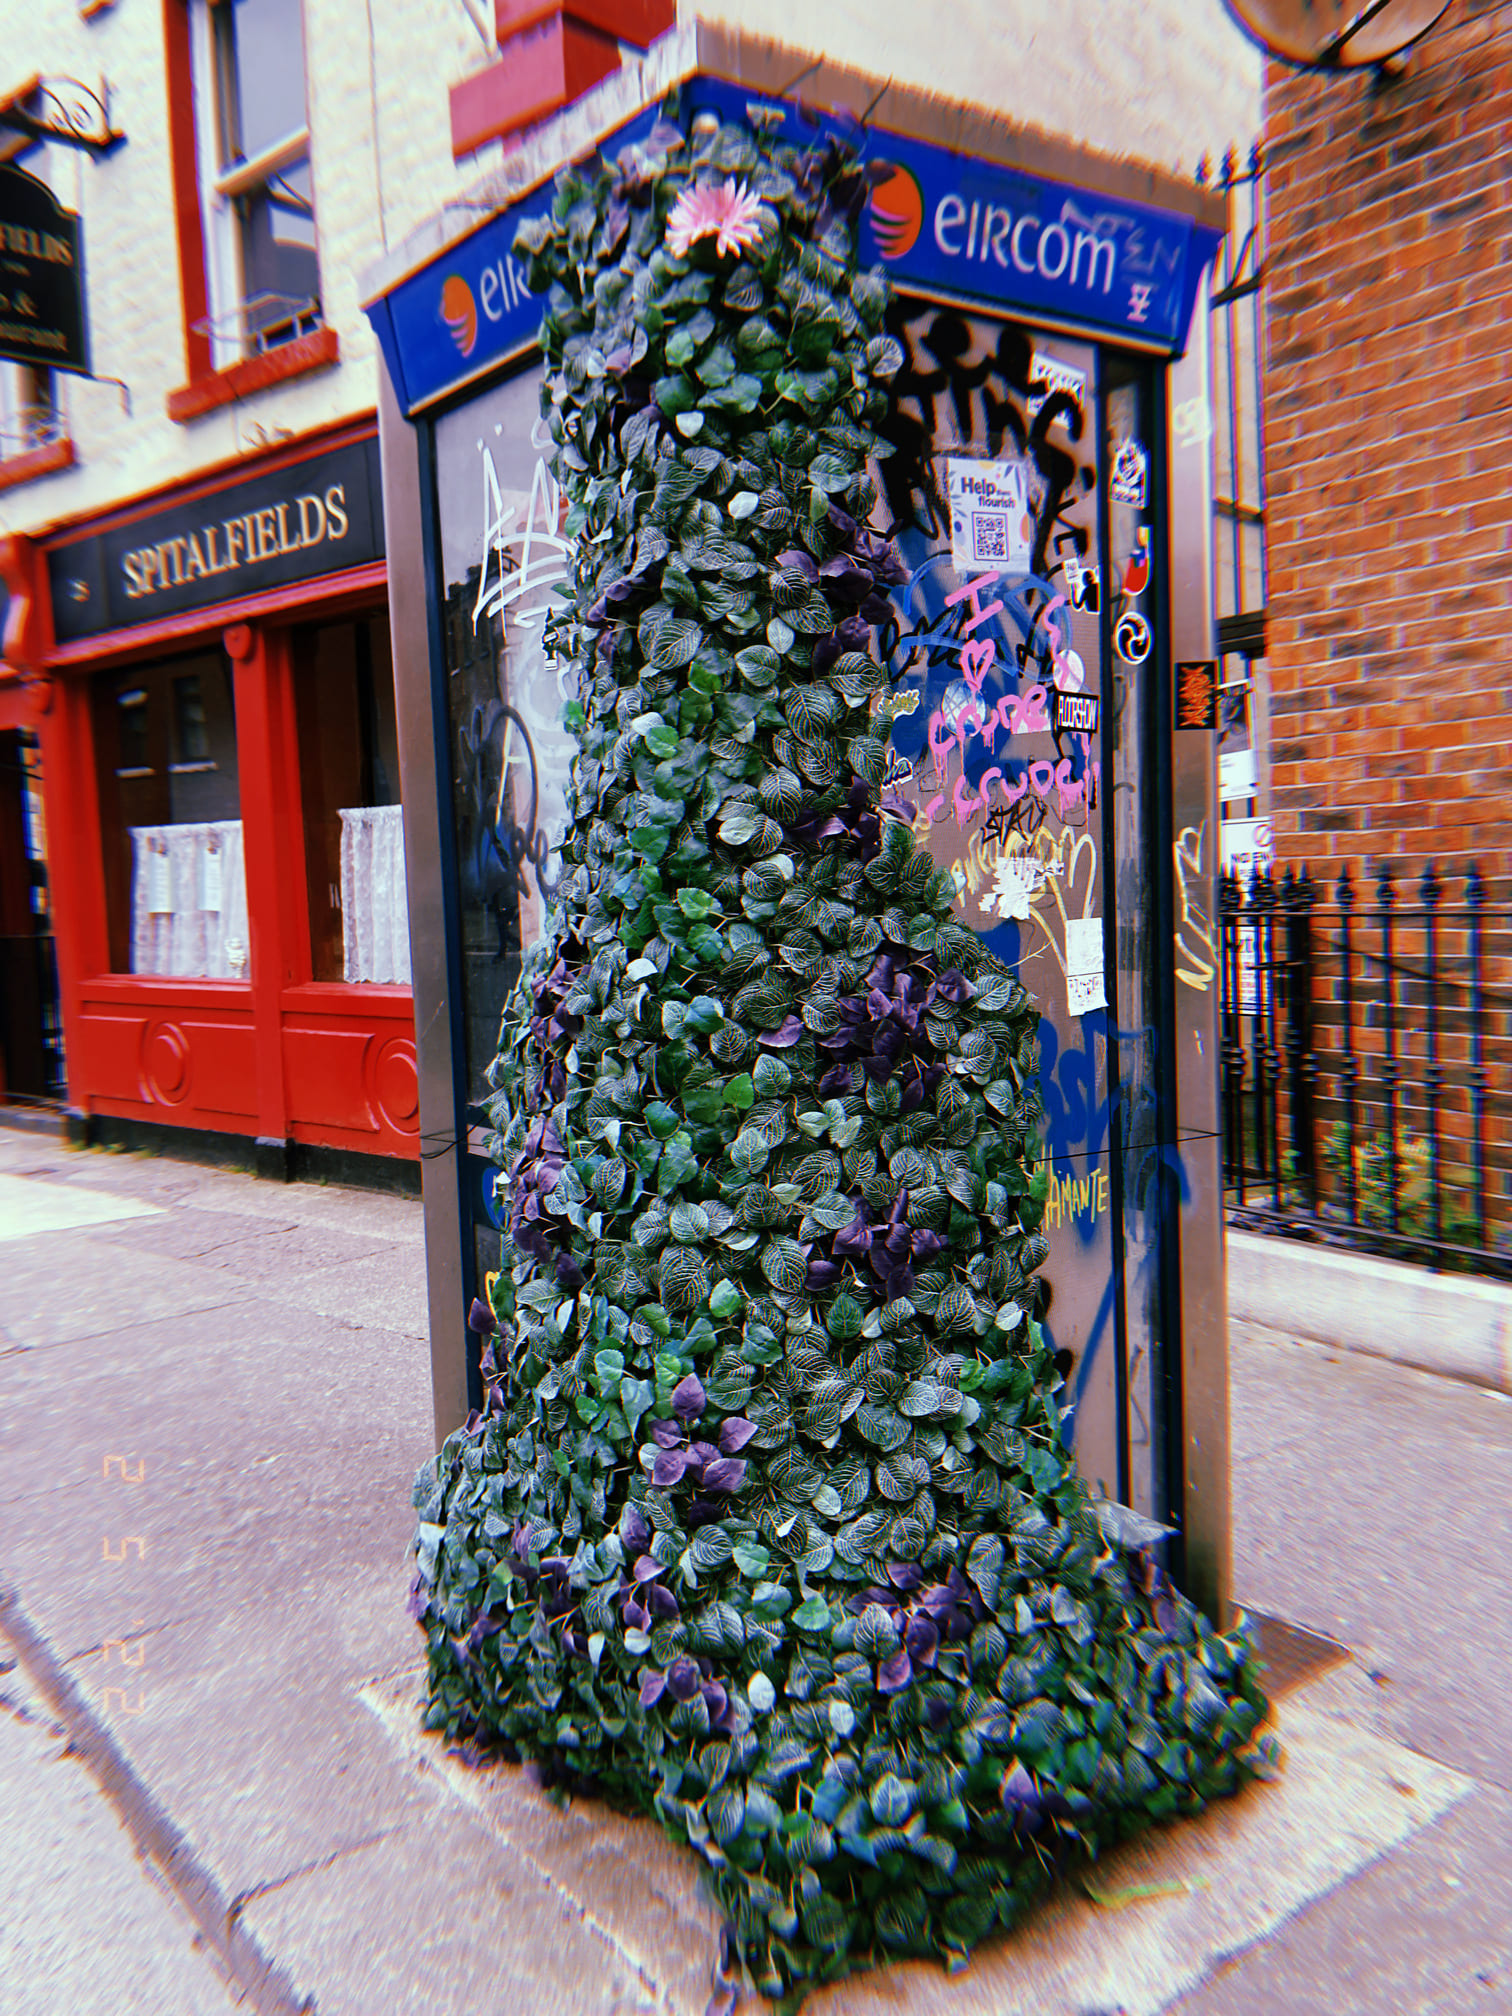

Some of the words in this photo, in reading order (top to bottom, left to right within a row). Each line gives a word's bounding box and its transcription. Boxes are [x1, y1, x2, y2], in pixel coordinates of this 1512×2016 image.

[933, 192, 1117, 296] eircom
[960, 476, 997, 497] Help
[978, 495, 1017, 509] flourish
[121, 484, 349, 599] SPITALFIELDS
